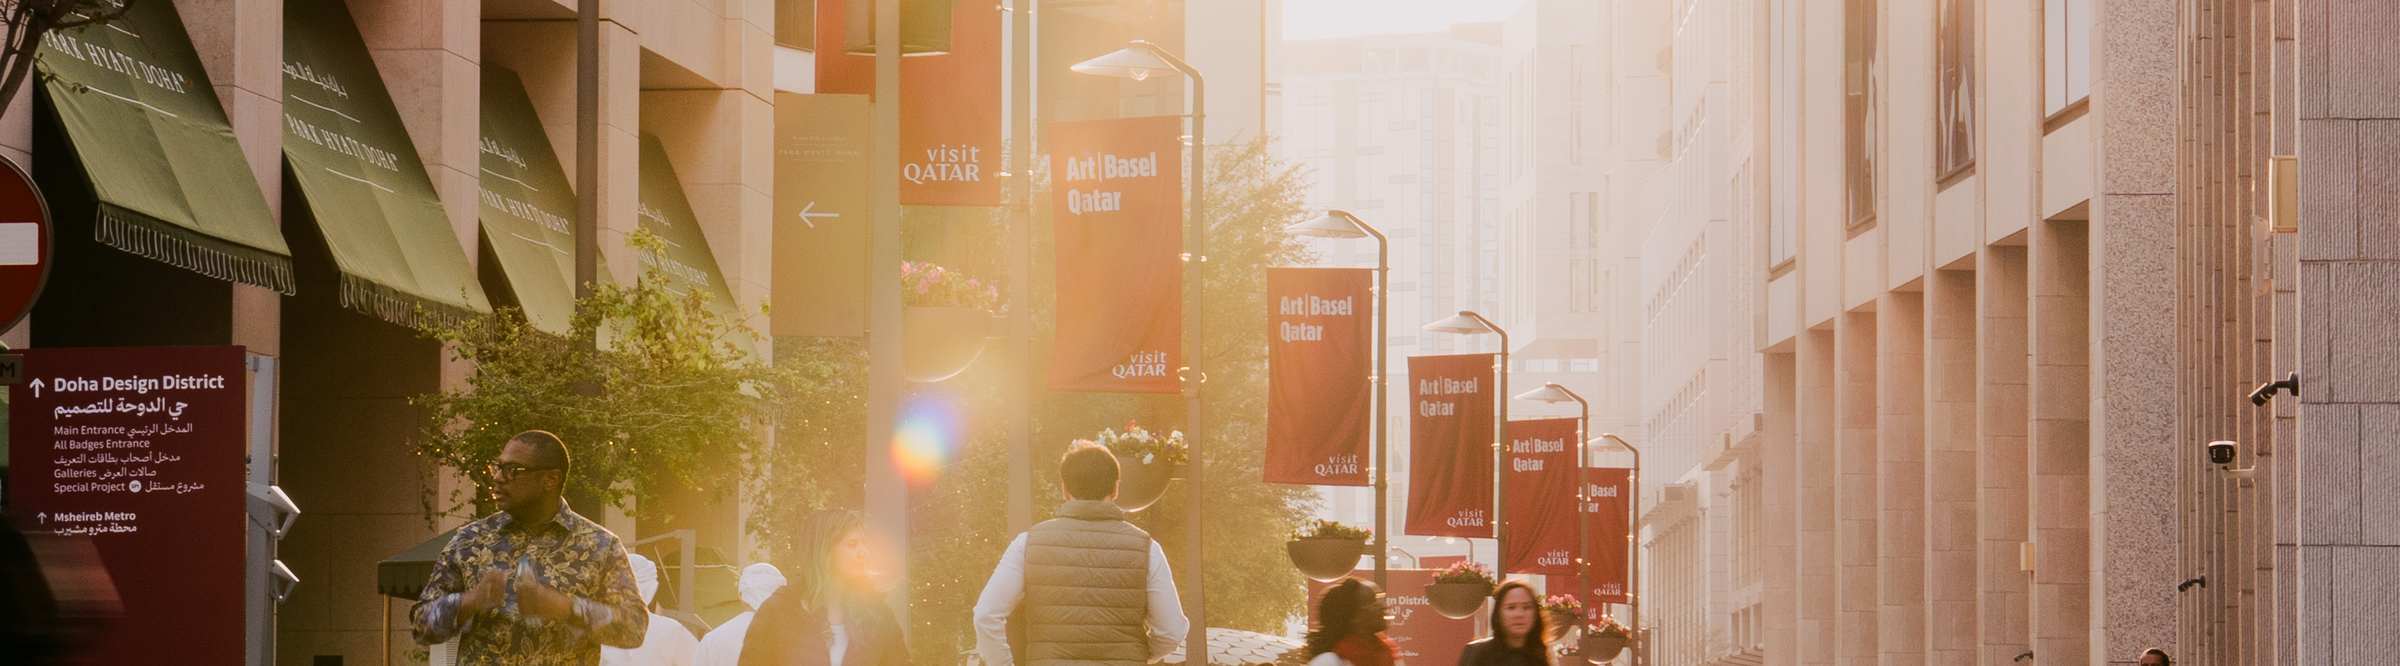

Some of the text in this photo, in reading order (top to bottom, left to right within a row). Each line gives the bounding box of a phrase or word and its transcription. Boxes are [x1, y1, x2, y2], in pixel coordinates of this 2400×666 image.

[43, 28, 85, 60] PARK
[84, 43, 140, 79] HYATT
[285, 113, 323, 145] PARK
[320, 129, 365, 160] HYATT
[926, 143, 980, 163] visit
[903, 163, 980, 185] QATAR
[1067, 188, 1121, 216] Qatar
[506, 197, 544, 225] HYATT
[1280, 321, 1323, 343] Qatar
[1130, 350, 1167, 364] visit
[1112, 363, 1166, 379] QATAR
[54, 374, 225, 394] Doha Design District
[54, 397, 188, 420] حي الدوحة للتصميم
[1420, 400, 1454, 418] Qatar
[54, 425, 126, 435] Main Entrance
[160, 423, 193, 436] المدخل
[54, 439, 151, 451] All Badges Entrance
[54, 451, 181, 466] مدخل أصحاب بطاقات التعريف
[1329, 453, 1358, 464] visit
[1513, 457, 1544, 473] Qatar
[54, 468, 97, 479] Galleries
[98, 466, 157, 480] صالات العرض
[1314, 463, 1358, 477] QATAR
[54, 482, 89, 494] Special
[91, 482, 126, 493] Project
[145, 481, 204, 494] مشروع مستقل
[54, 511, 136, 522] Msheireb Metro
[1458, 508, 1484, 518] visit
[54, 522, 137, 536] محطة مترو مشيرب
[1447, 517, 1484, 528] QATAR
[1547, 549, 1569, 557] visit
[1537, 556, 1569, 566] QATAR
[1594, 588, 1621, 596] QATAR
[1399, 595, 1430, 606] Distric
